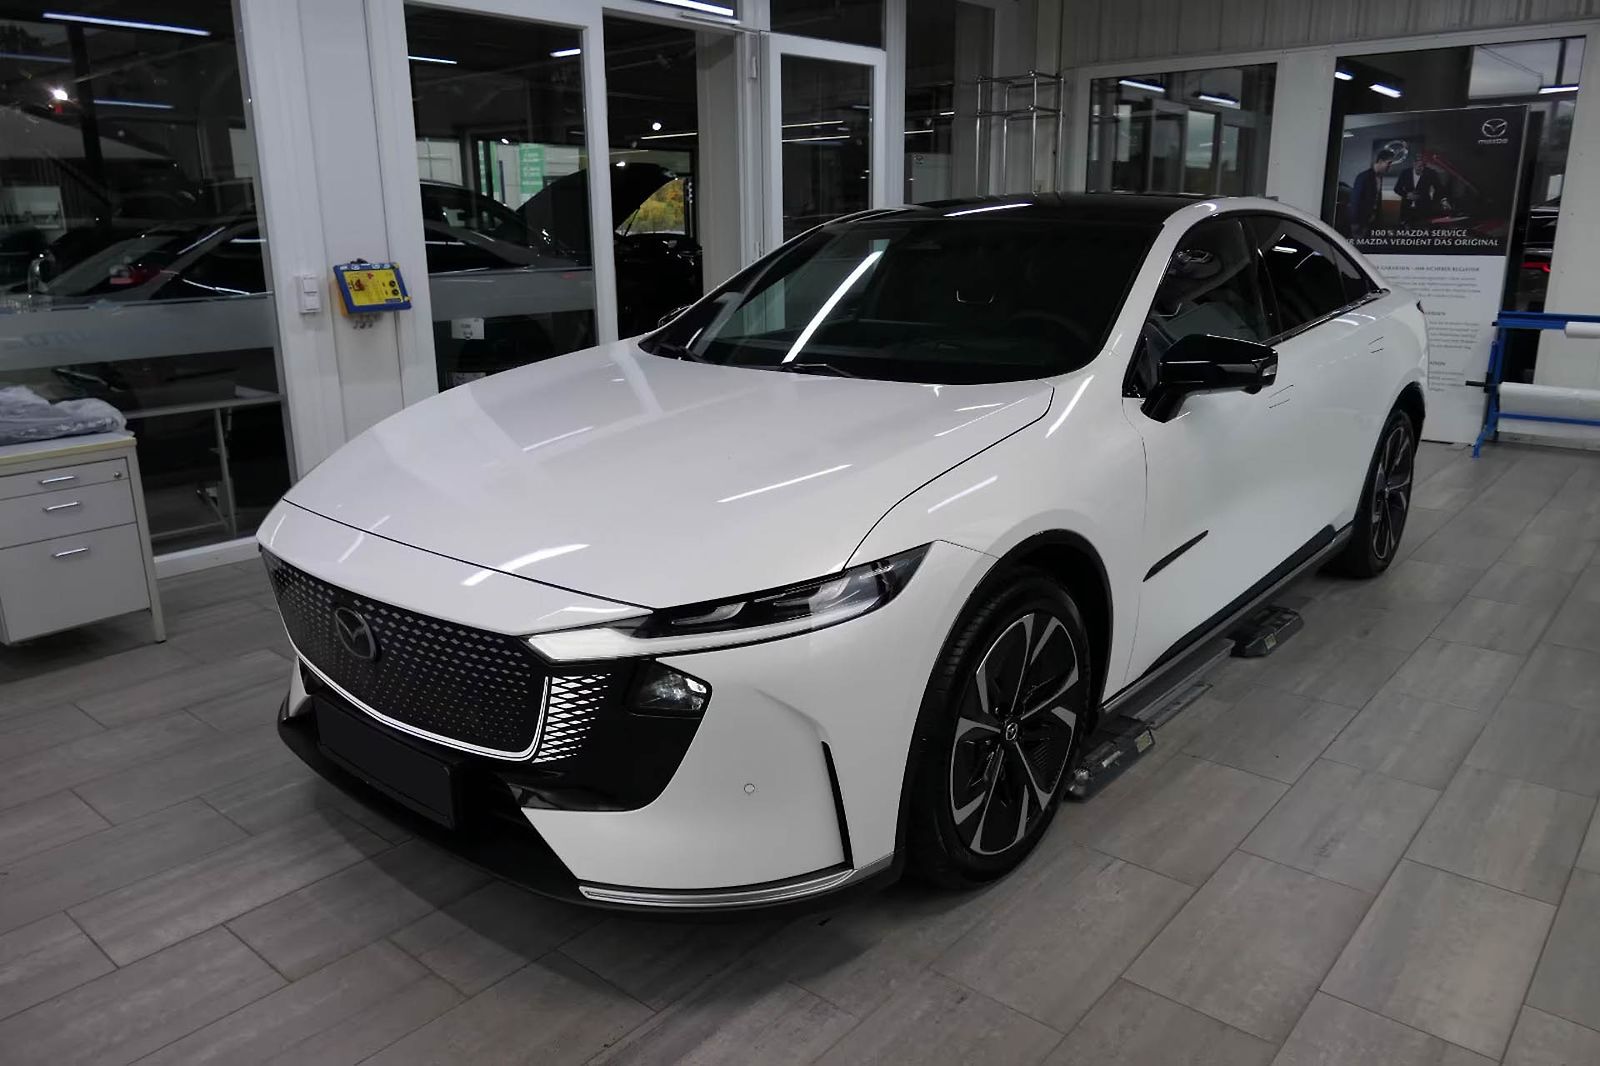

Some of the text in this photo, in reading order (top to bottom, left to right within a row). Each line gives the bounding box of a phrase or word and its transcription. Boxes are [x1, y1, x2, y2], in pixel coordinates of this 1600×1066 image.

[1370, 229, 1386, 237] 100
[1395, 229, 1429, 237] MAZDA
[1431, 229, 1468, 237] SERVICE
[1356, 238, 1388, 246] MAZDA
[1389, 238, 1432, 246] VERDIENT
[1433, 238, 1452, 246] DAS
[1454, 238, 1499, 246] ORIGINAL
